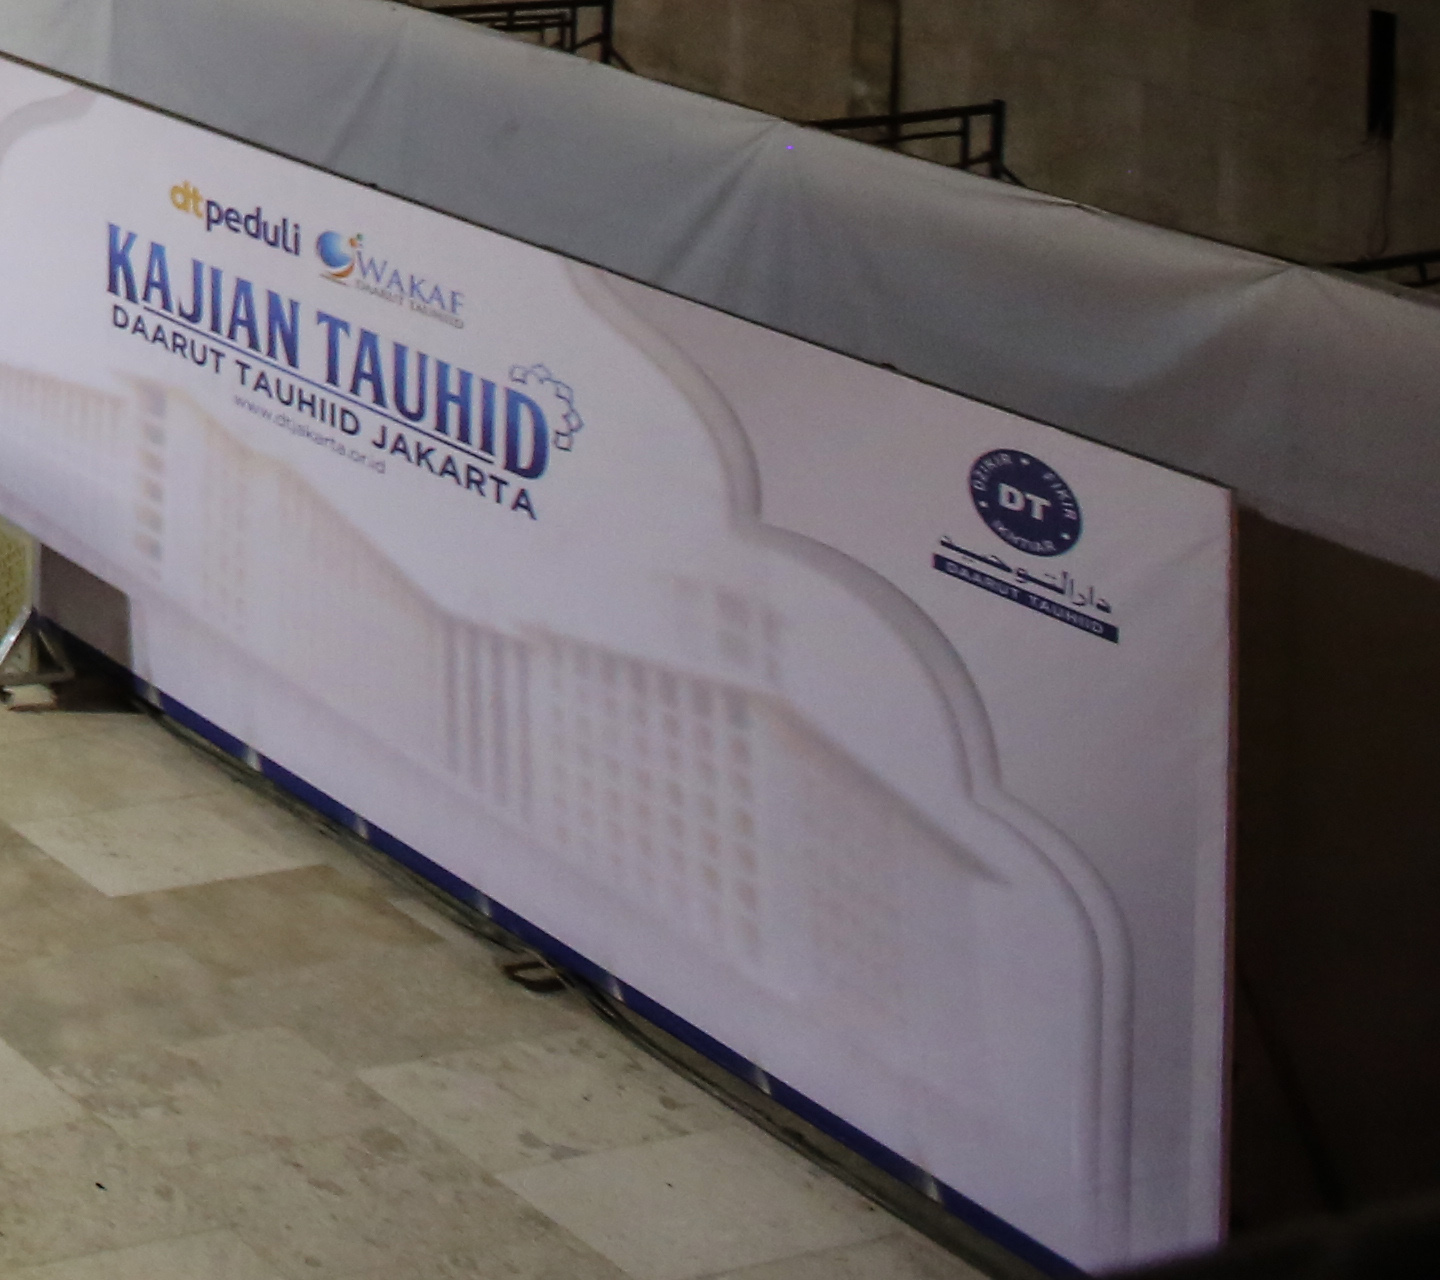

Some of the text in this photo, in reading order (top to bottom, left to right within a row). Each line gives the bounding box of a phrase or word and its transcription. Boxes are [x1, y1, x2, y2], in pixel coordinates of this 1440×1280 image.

[107, 223, 550, 481] KAJIAN TAUHID
[357, 251, 465, 315] WAKAF
[112, 304, 538, 521] DAARUT TAUHIID JAKARTA
[998, 482, 1051, 521] DT
